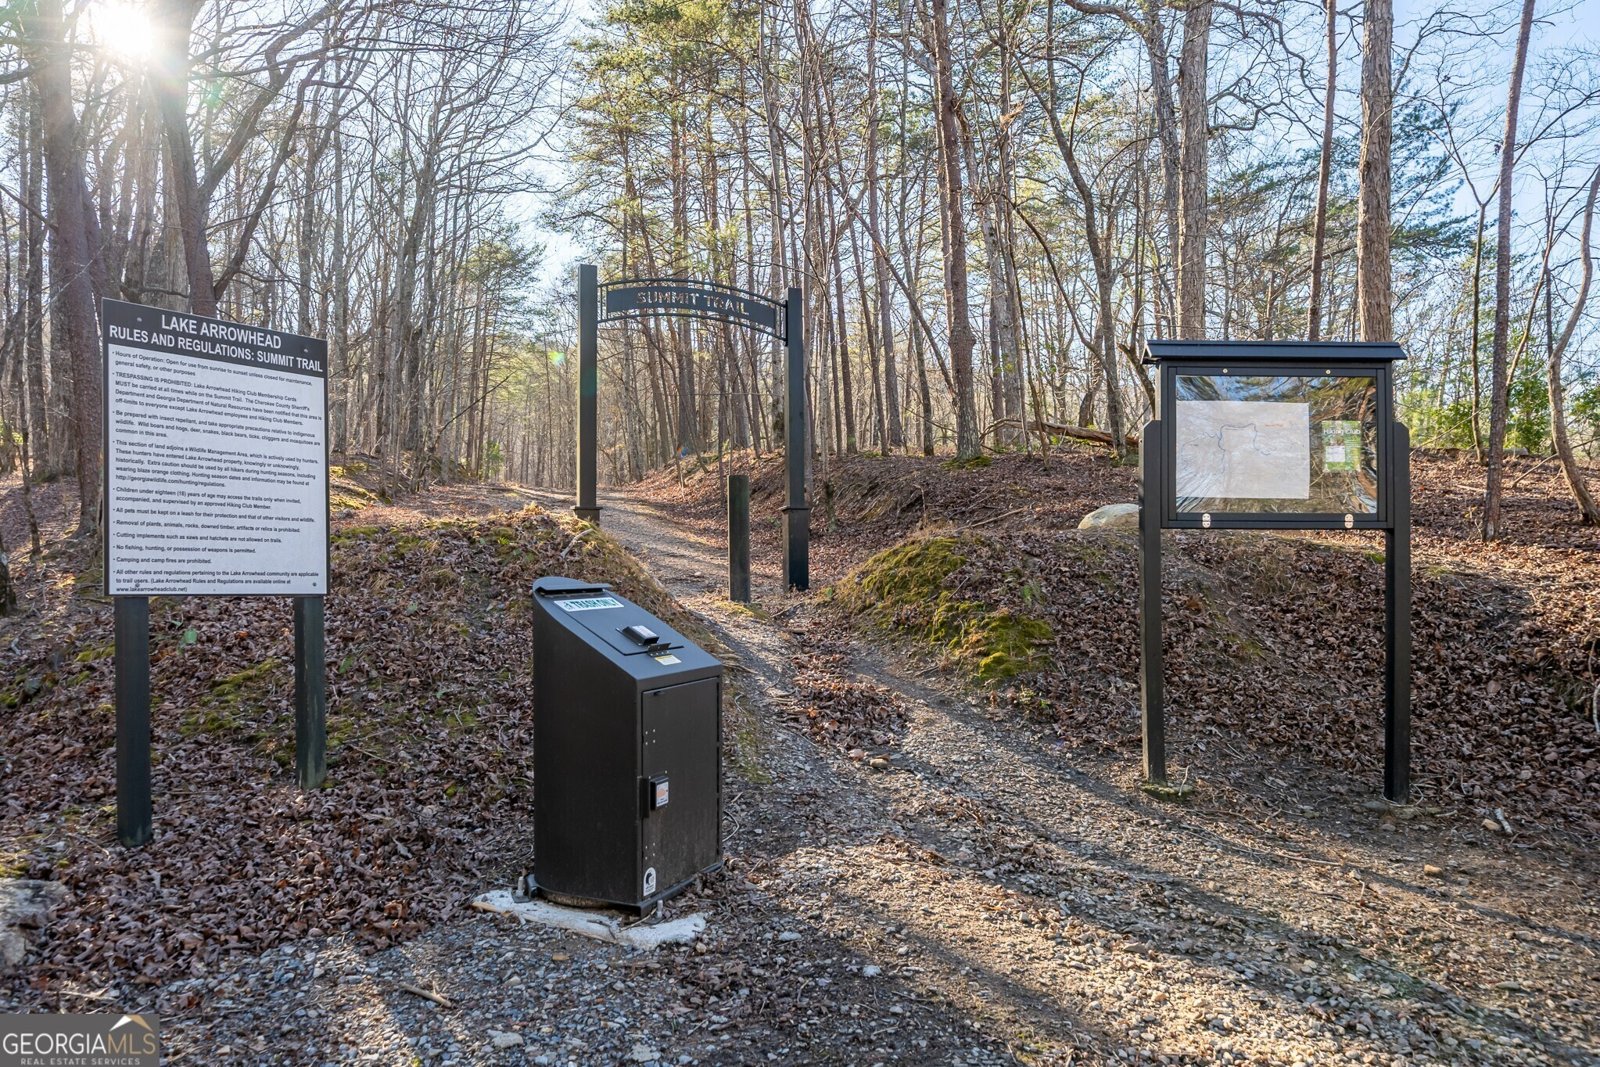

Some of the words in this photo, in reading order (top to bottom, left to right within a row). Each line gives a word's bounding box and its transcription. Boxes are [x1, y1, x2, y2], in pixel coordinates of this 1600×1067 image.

[637, 292, 700, 305] SUMMIT
[704, 296, 750, 316] TRAIL
[162, 314, 197, 334] LAKE
[200, 322, 281, 349] ARROWHEAD
[110, 325, 148, 343] RULES
[151, 332, 175, 347] AND
[178, 337, 254, 361] REGULATIONS:
[257, 350, 294, 367] SUMMIT
[296, 357, 323, 372] TRAIL
[258, 392, 283, 400] Membership
